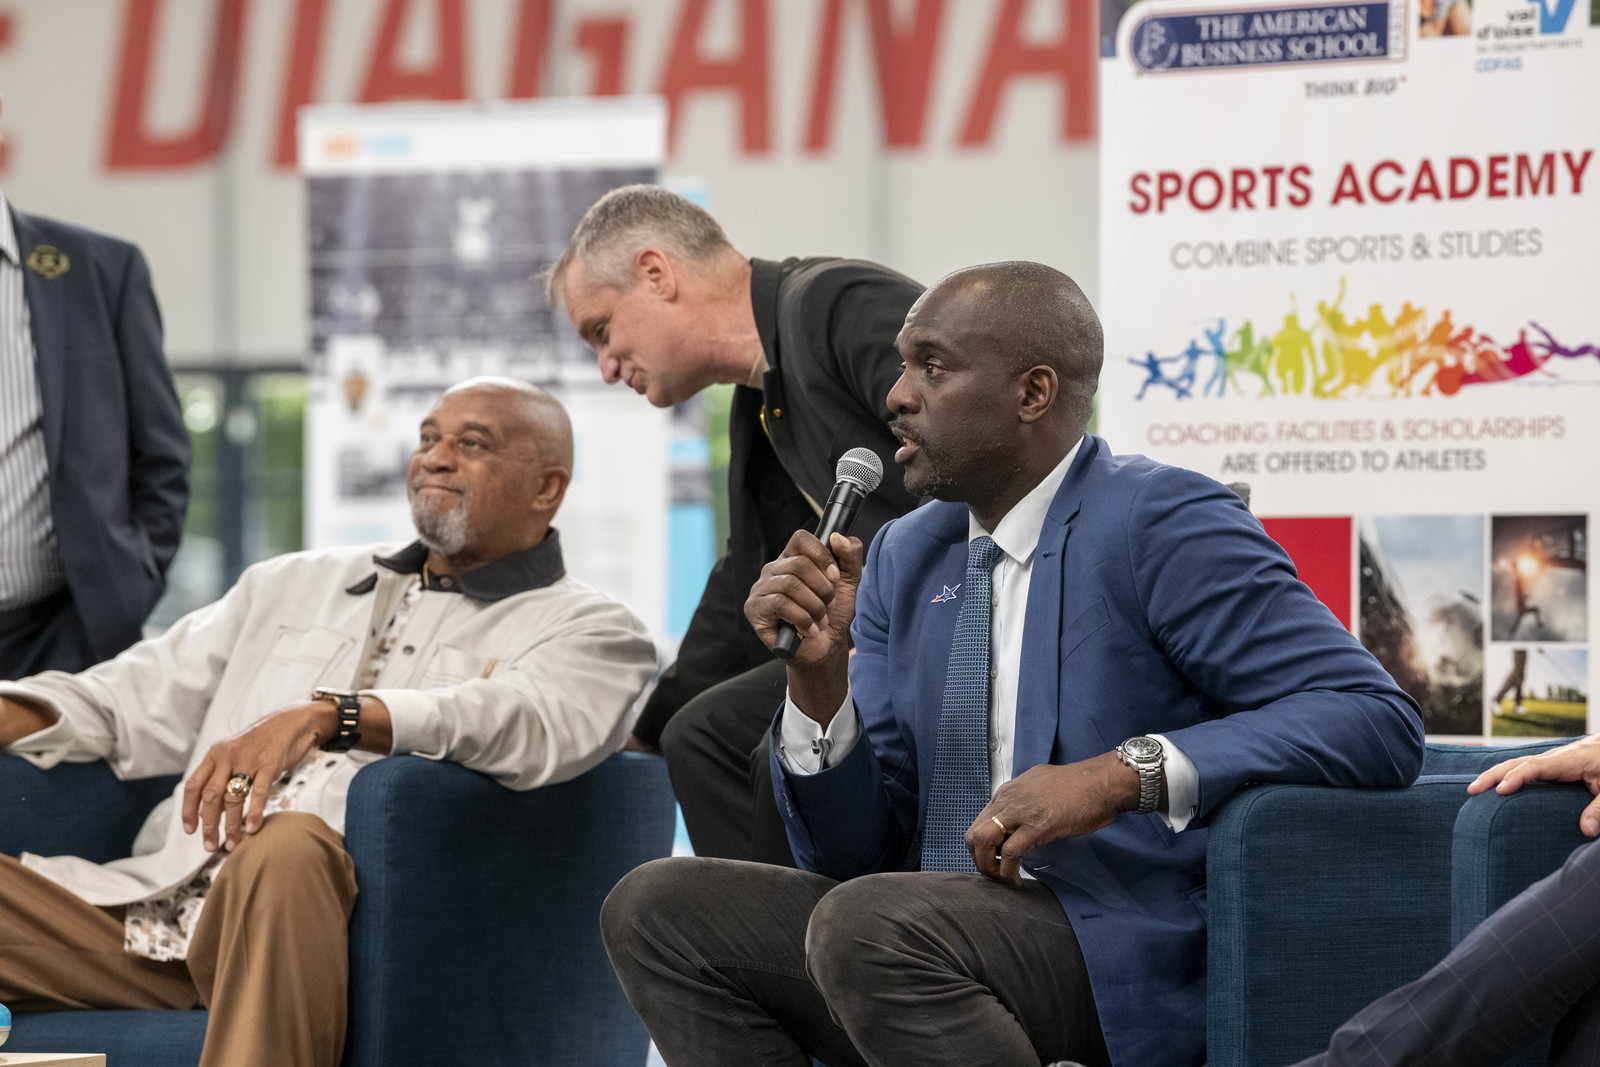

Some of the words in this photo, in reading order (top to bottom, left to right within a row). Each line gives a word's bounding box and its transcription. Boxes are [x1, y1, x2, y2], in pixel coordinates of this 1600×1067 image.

[1196, 14, 1245, 40] THE
[1248, 6, 1368, 37] AMERICAN
[1181, 37, 1283, 67] BUSINESS
[1286, 32, 1385, 61] SCHOOL
[1304, 80, 1358, 99] THINK
[1364, 77, 1398, 97] BIG
[1129, 164, 1313, 215] SPORTS
[1330, 150, 1594, 207] ACADEMY
[1170, 237, 1298, 271] COMBINE
[1304, 233, 1403, 265] SPORTS
[1410, 232, 1433, 261] &
[1438, 228, 1544, 260] STUDIES
[1277, 419, 1376, 444] FACILITIES
[1381, 418, 1398, 442] &
[1403, 416, 1566, 441] SCHOLARSHIPS
[1220, 452, 1258, 476] ARE
[1264, 450, 1357, 474] OFFERED
[1361, 449, 1390, 473] TO
[1394, 448, 1487, 472] ATHLETES
